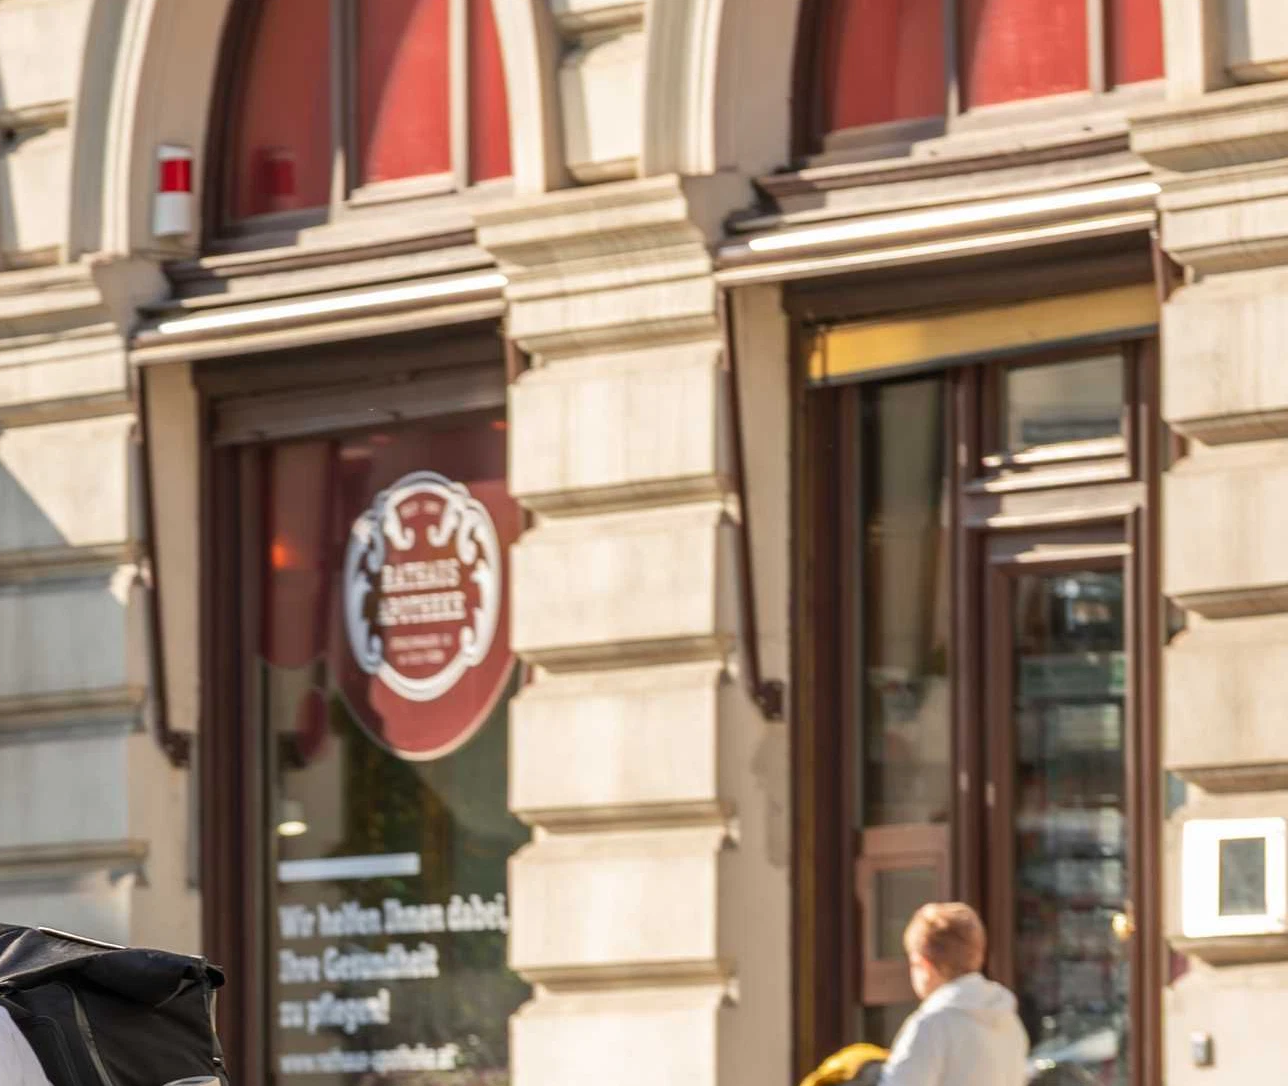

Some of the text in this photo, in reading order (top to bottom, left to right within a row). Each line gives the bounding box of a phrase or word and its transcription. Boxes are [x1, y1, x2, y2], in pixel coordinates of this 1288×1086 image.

[278, 904, 316, 940] Wir
[318, 900, 381, 935] helfen
[383, 898, 445, 935] Ihnen
[279, 942, 440, 985] Ihre Gesundheit
[279, 1001, 305, 1028] zu
